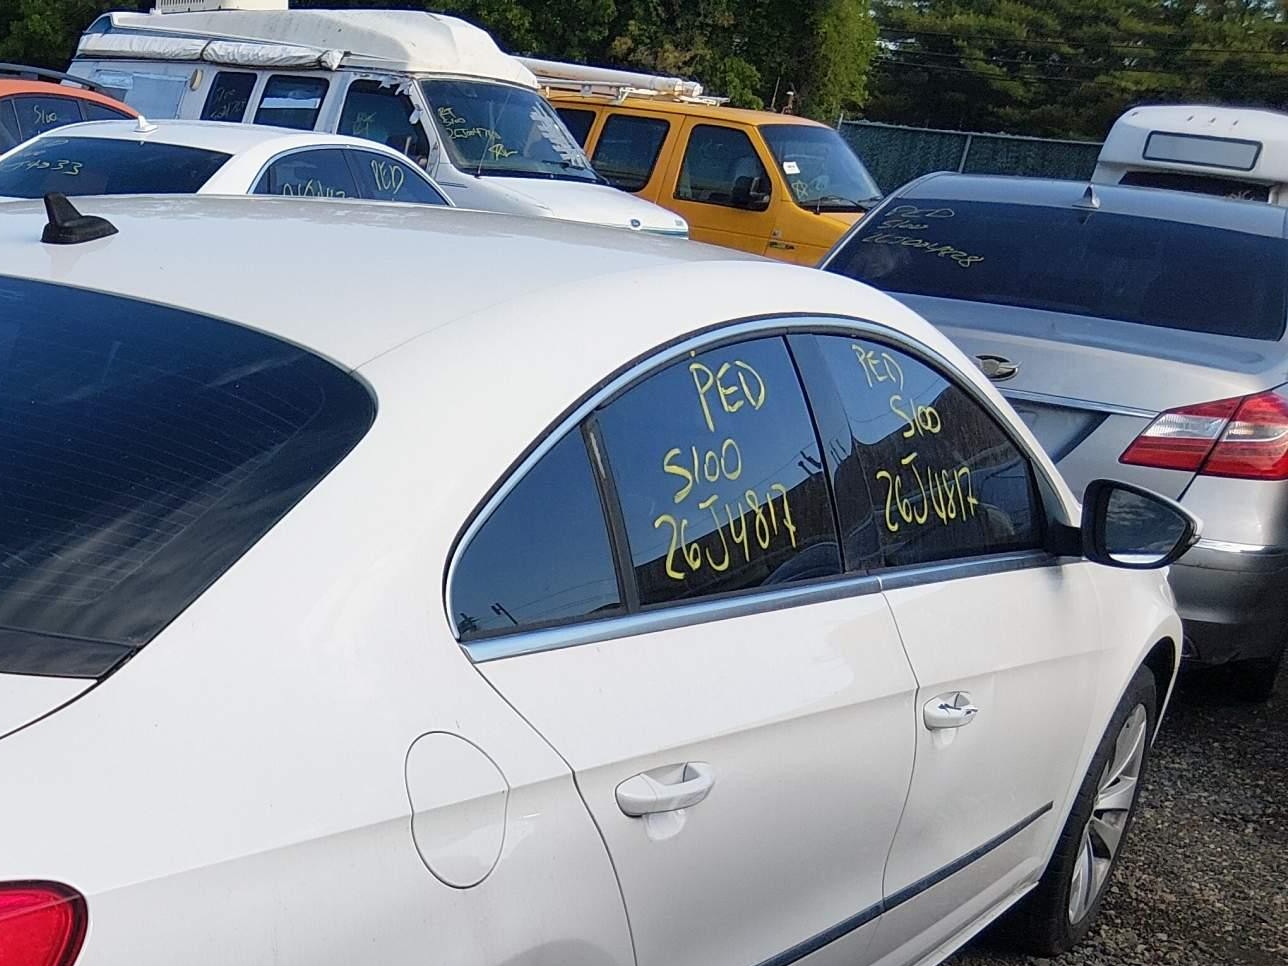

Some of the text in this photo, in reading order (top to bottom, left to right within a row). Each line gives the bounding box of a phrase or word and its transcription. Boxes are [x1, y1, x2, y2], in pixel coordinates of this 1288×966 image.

[370, 160, 405, 194] PED
[688, 358, 767, 433] PED
[851, 343, 905, 391] PED
[888, 393, 942, 439] S100
[662, 437, 744, 504] S100
[875, 451, 979, 533] 26J4817
[653, 482, 797, 581] 26J4817
